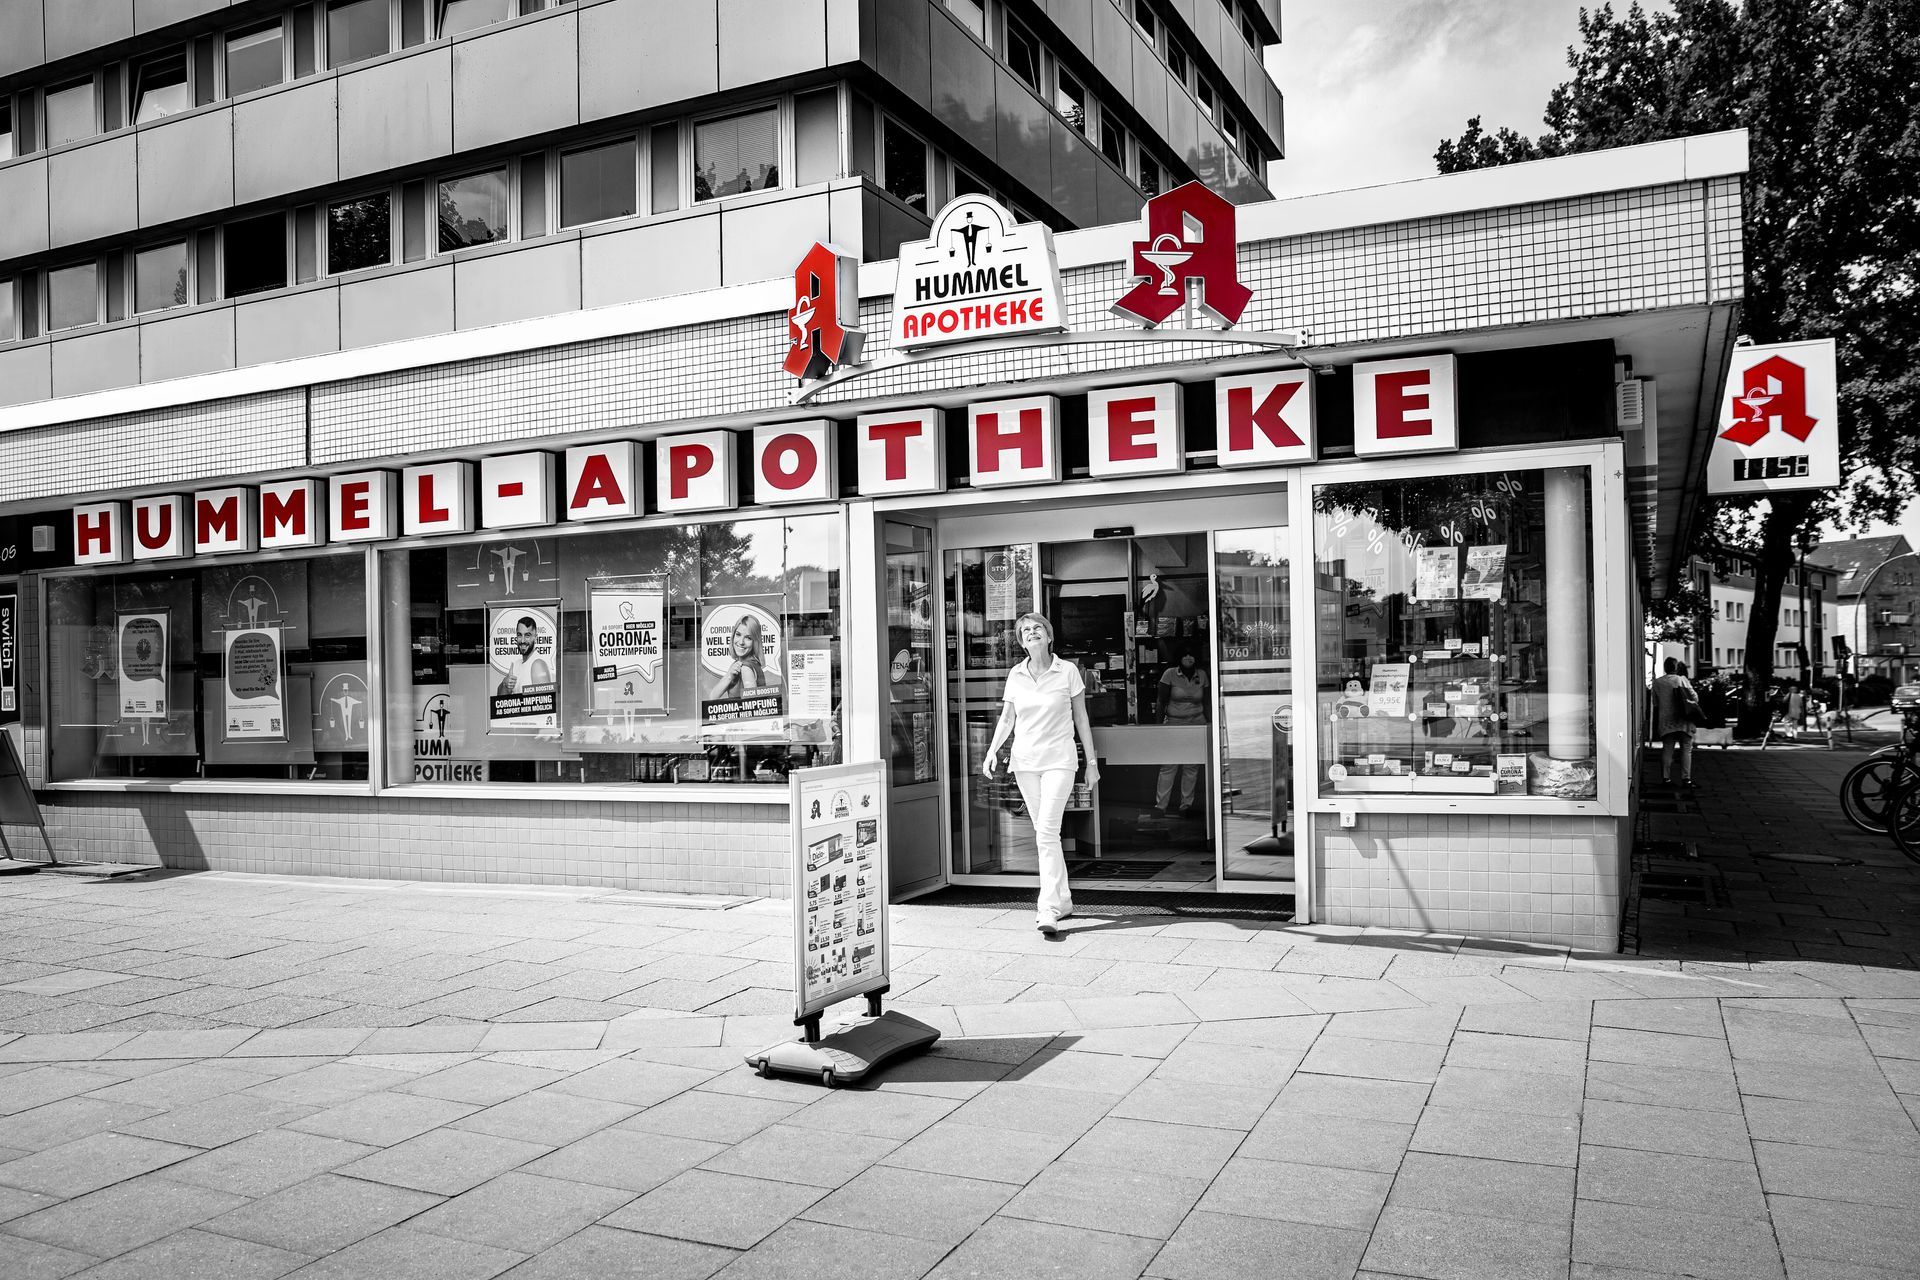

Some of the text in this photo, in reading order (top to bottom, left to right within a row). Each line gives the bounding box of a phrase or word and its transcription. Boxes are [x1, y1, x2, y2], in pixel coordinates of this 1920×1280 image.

[915, 263, 1029, 302] HUMMEL
[903, 297, 1043, 339] APOTHEKE
[1, 607, 14, 669] switch
[494, 637, 508, 645] WEIL
[599, 631, 657, 647] CORONA-
[706, 637, 722, 645] WEIL
[600, 646, 657, 657] SCHUTZIMPFUNG
[1224, 647, 1249, 658] 1960
[892, 662, 910, 670] TENA
[743, 687, 779, 697] AUCH BOOSTER
[496, 695, 552, 708] CORONA-IMPFUNG
[521, 705, 531, 713] HIER
[532, 703, 552, 712] MÖGLICH
[708, 698, 777, 714] CORONA-IMPFUNG
[709, 707, 778, 721] AB SOFORT HIER MÖGLICH
[414, 764, 482, 781] POTHEKE
